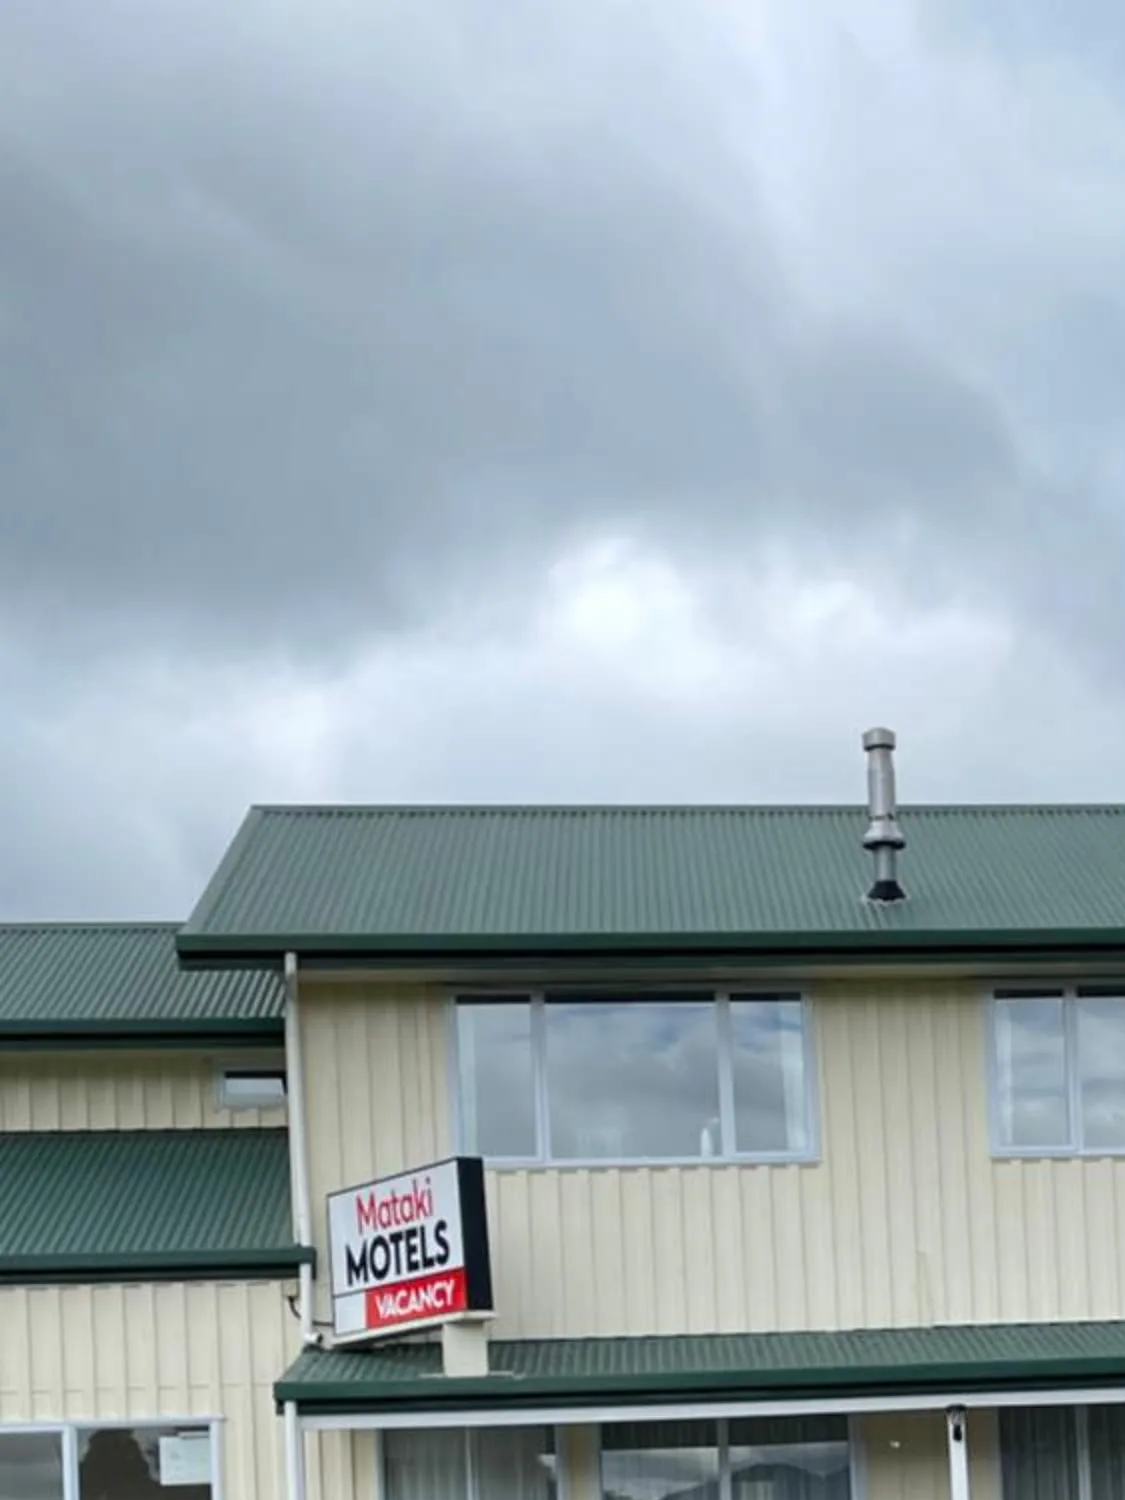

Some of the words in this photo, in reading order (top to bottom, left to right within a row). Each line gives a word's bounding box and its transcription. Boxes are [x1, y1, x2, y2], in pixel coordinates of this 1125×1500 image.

[355, 1177, 434, 1235] Mataki
[345, 1219, 450, 1287] MOTELS
[375, 1279, 455, 1319] VACANCY
